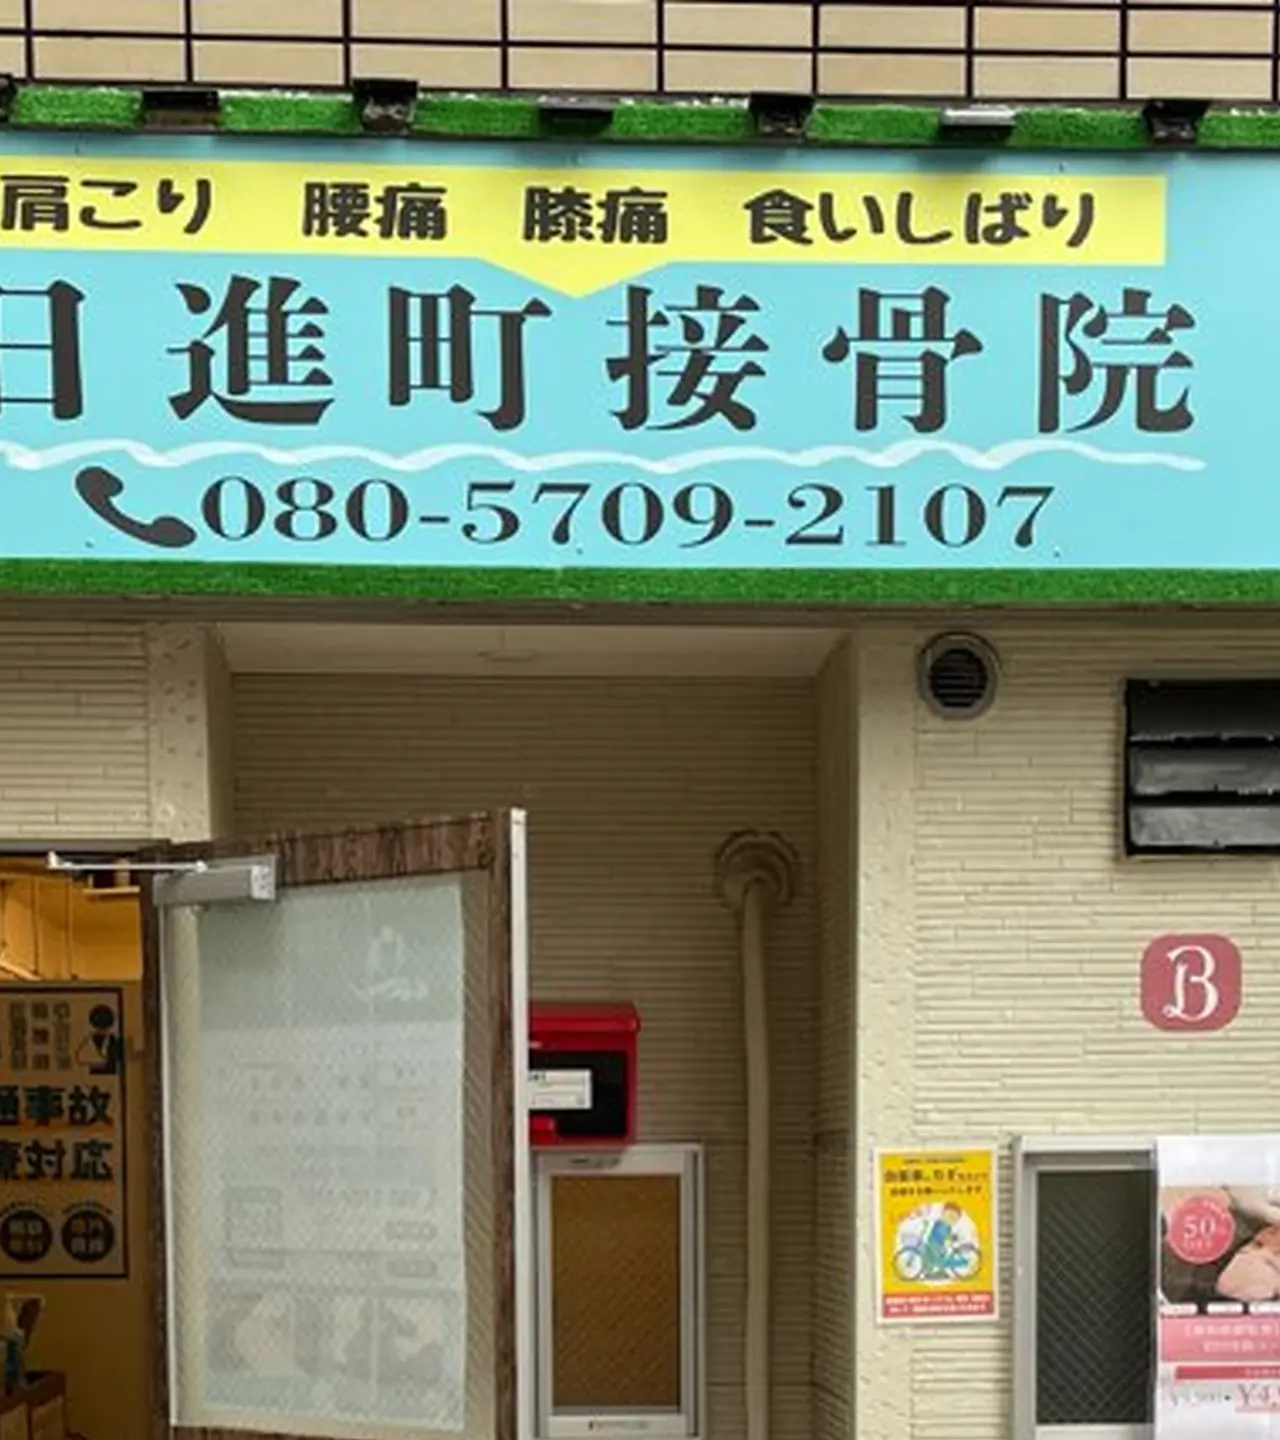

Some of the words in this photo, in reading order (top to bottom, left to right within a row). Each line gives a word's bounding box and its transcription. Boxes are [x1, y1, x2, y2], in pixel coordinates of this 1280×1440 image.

[0, 173, 213, 235] 肩こり
[301, 181, 448, 241] 腰痛
[521, 187, 669, 245] 膝痛
[742, 190, 1098, 247] 食いしばり
[199, 474, 1058, 548] 080-5709-2107
[1183, 1214, 1216, 1239] 50
